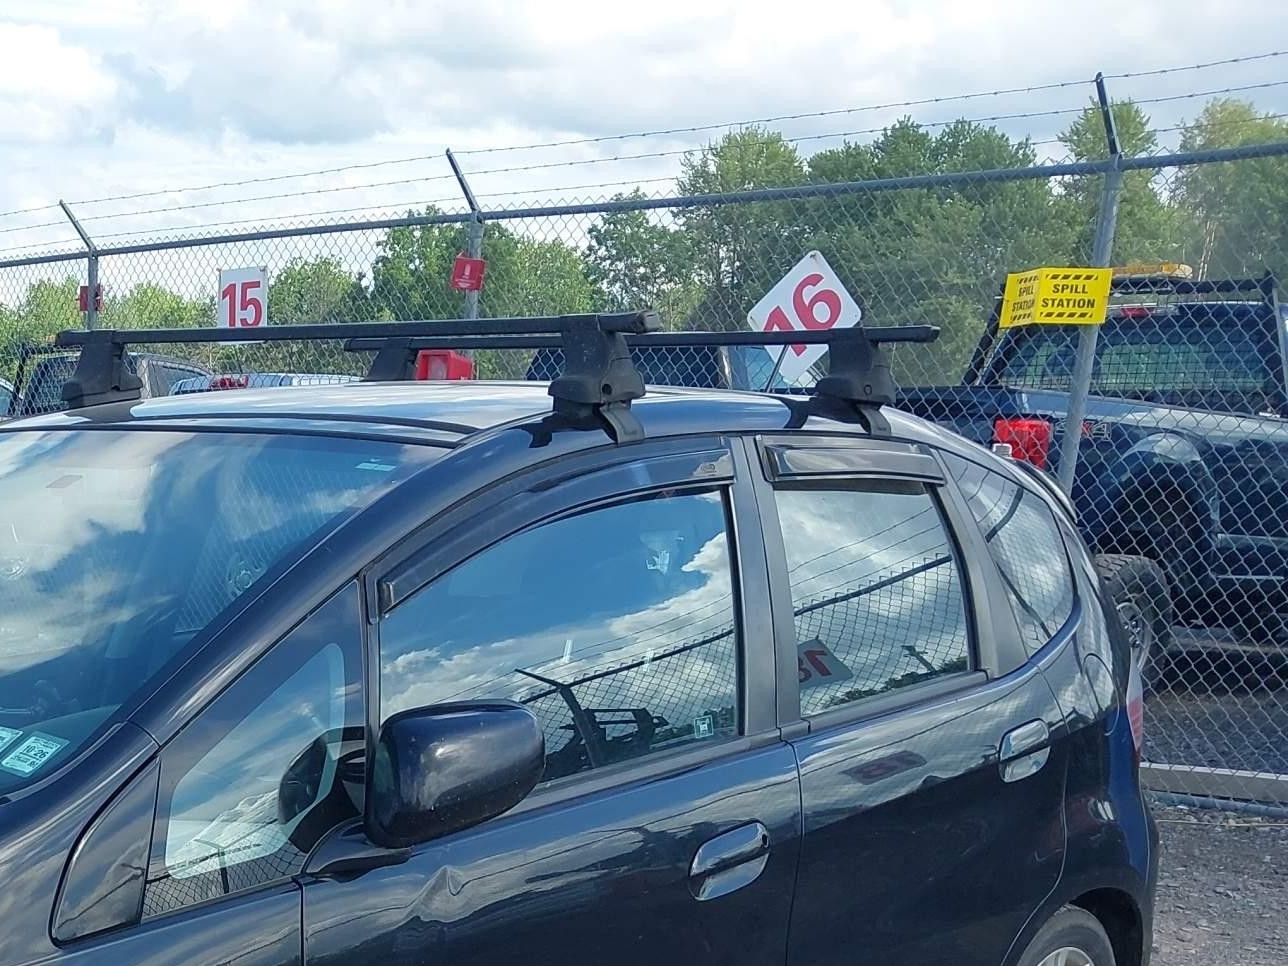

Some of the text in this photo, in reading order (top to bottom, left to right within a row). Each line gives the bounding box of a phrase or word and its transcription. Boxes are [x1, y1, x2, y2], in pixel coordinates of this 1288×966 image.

[1018, 286, 1034, 298] SPILL
[1052, 283, 1088, 294] SPILL
[221, 280, 262, 328] 15
[1041, 298, 1095, 308] STATION
[762, 273, 841, 357] 16
